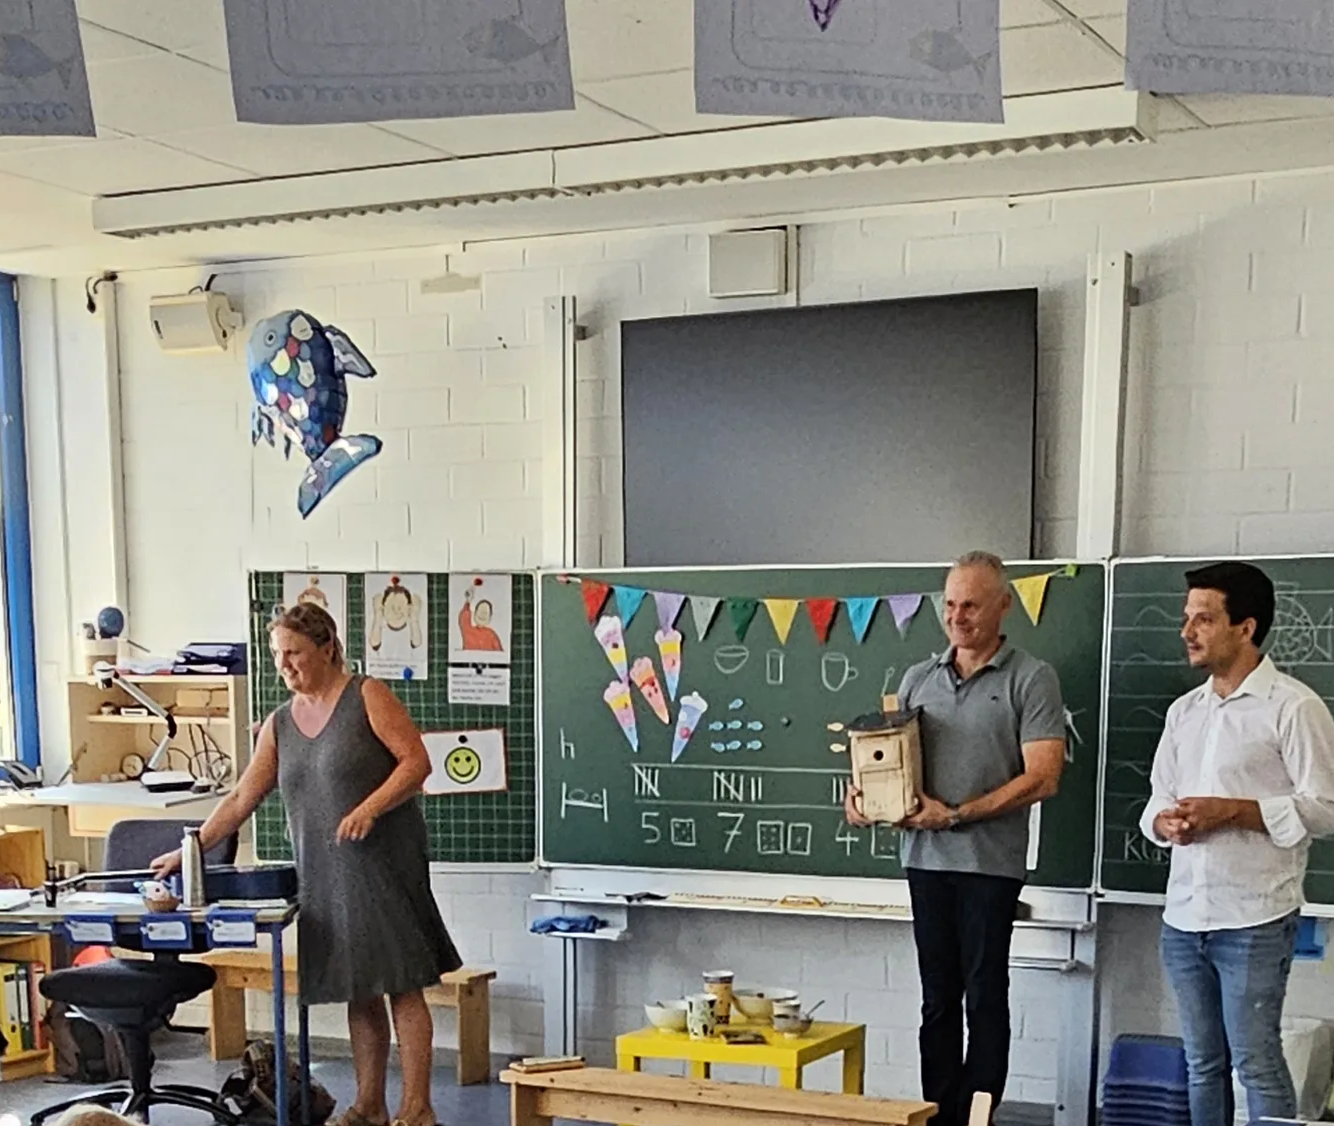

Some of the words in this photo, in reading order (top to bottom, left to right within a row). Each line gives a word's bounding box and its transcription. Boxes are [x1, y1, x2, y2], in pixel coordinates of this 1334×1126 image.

[559, 728, 575, 760] h
[641, 811, 662, 844] 5
[717, 811, 745, 853] 7
[835, 819, 859, 856] 4
